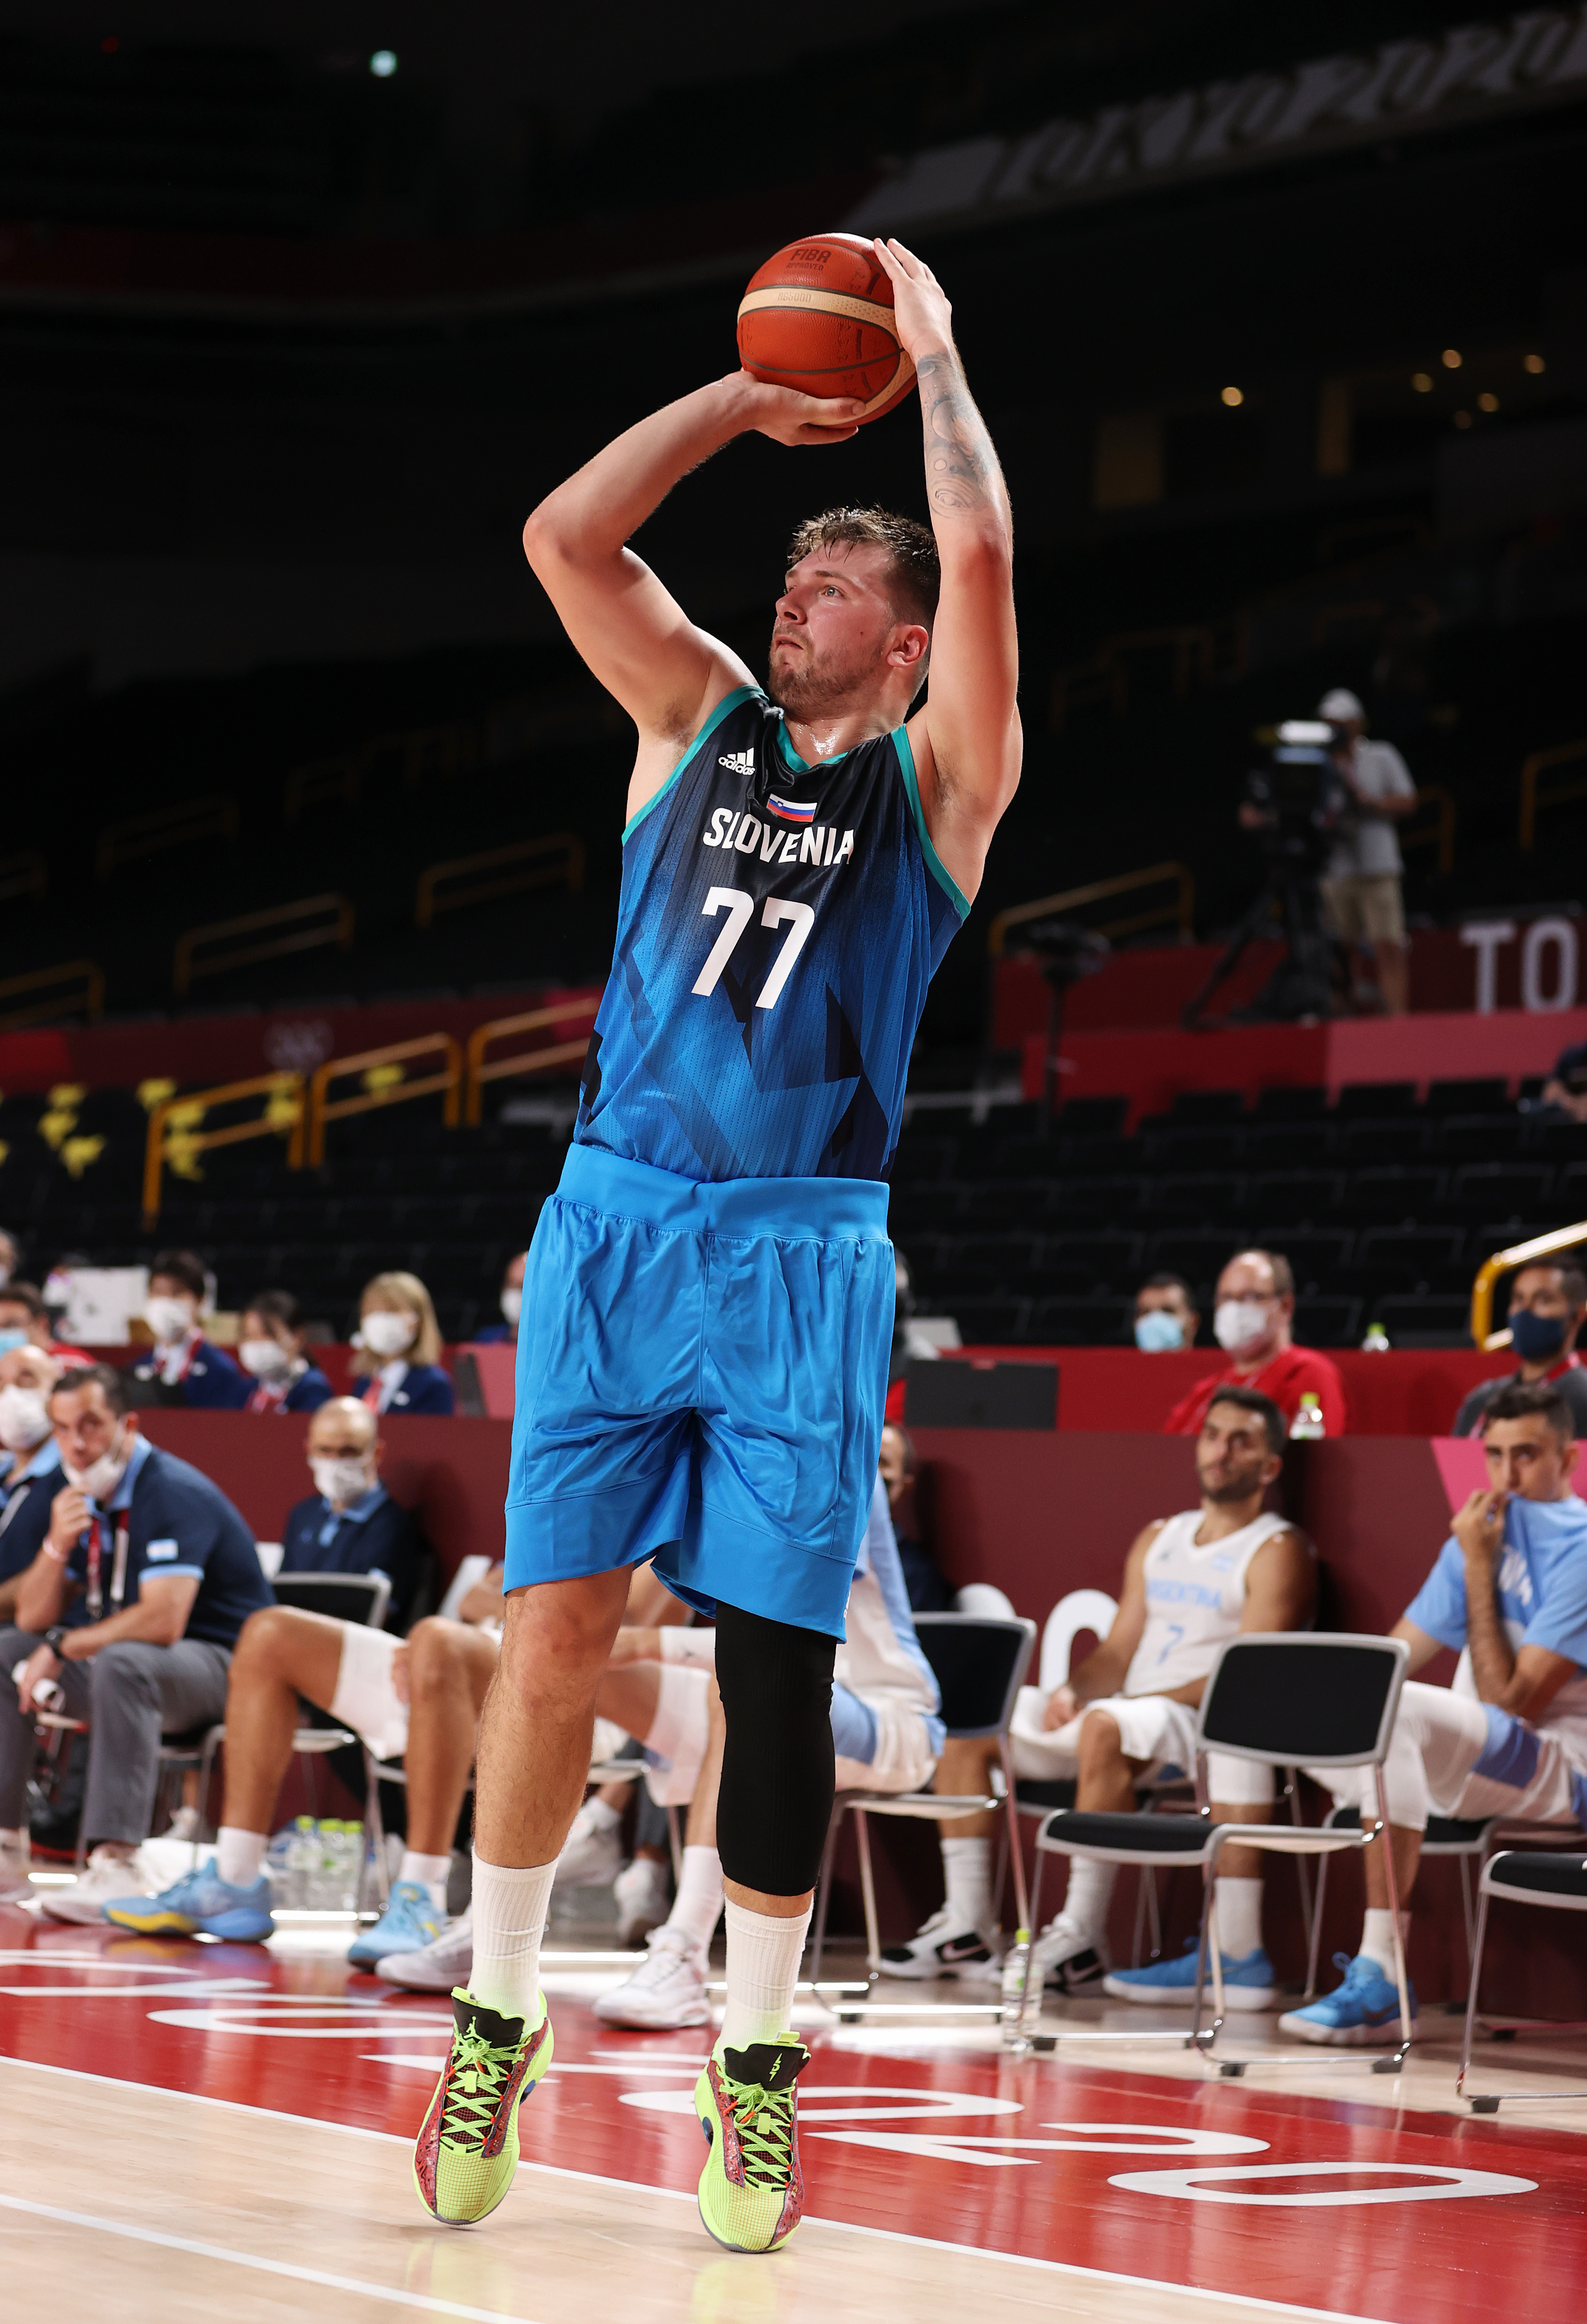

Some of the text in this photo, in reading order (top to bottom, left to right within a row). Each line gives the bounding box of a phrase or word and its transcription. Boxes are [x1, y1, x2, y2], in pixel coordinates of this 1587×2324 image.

[786, 262, 824, 271] APPROVED
[790, 249, 832, 263] FIBA
[718, 756, 756, 776] adidas
[703, 807, 855, 866] SLOVENIA
[691, 886, 816, 1010] 77
[1157, 1624, 1185, 1666] 7
